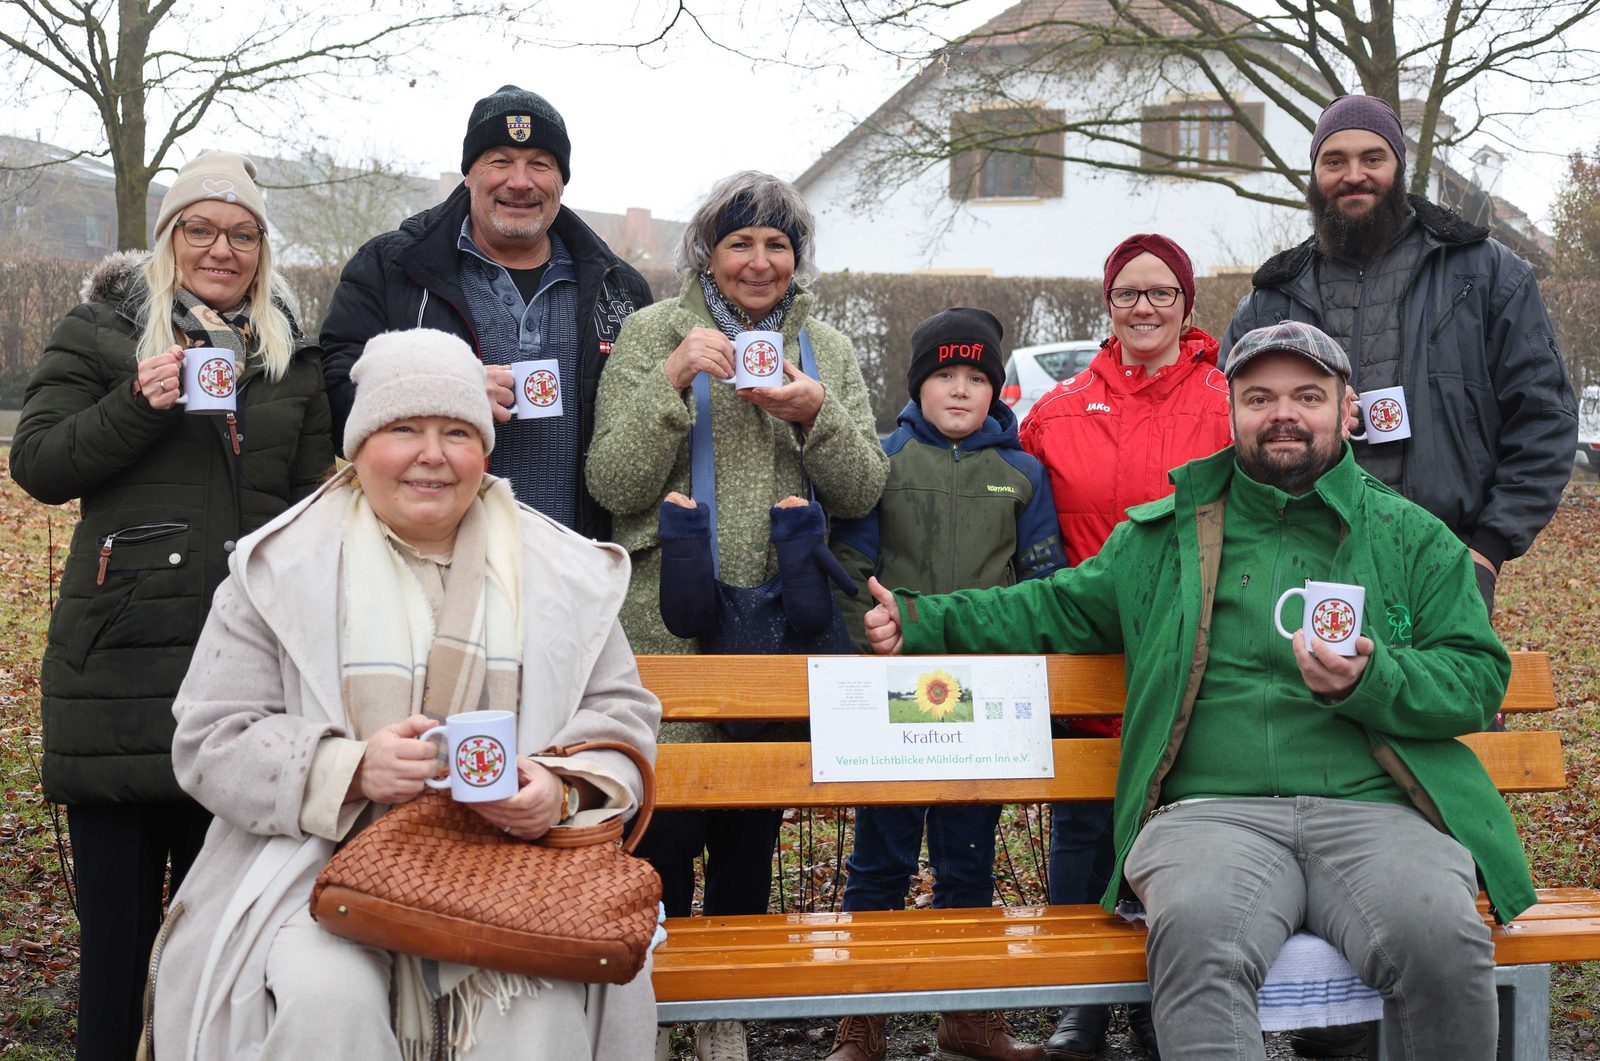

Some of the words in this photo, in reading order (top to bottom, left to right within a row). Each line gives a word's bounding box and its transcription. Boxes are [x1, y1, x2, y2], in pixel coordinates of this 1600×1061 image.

[939, 344, 984, 362] profi
[1085, 403, 1110, 412] JAKO
[903, 729, 963, 744] Kraftort
[835, 755, 868, 765] Verein
[871, 754, 924, 765] Lichtblicke
[927, 753, 973, 764] Mühldorf
[994, 753, 1010, 763] Inn
[1013, 752, 1030, 762] e.V.
